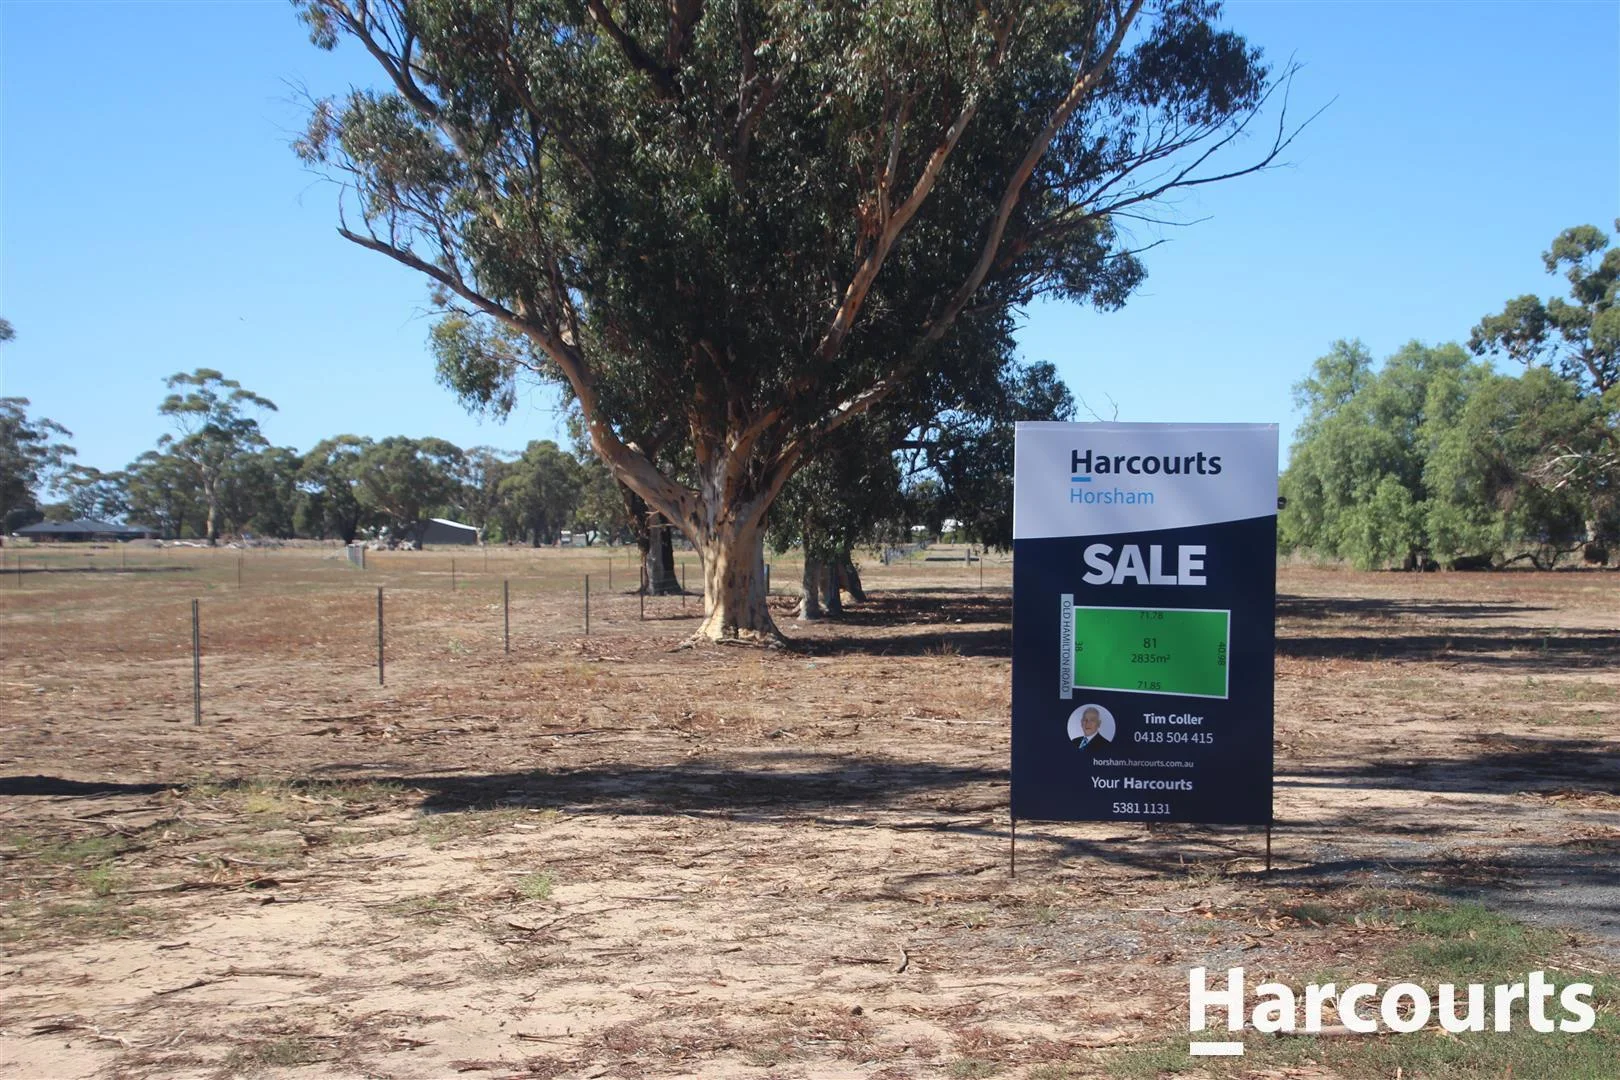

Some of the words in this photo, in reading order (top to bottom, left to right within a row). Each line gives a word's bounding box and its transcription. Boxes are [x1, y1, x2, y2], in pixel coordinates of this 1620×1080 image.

[1071, 449, 1222, 475] Harcourts
[1070, 488, 1154, 504] Horsham
[1082, 543, 1207, 586] SALE
[1062, 600, 1071, 619] OLD
[1062, 621, 1071, 666] HAMILTON
[1143, 638, 1157, 649] 81
[1061, 667, 1070, 693] ROAD
[1144, 713, 1165, 724] Tim
[1169, 714, 1204, 725] Coller
[1134, 731, 1163, 743] 0418
[1166, 732, 1188, 743] 504
[1191, 733, 1213, 744] 415
[1093, 758, 1194, 768] horsham.harcourts.com.au
[1091, 776, 1120, 788] Your
[1123, 777, 1193, 790] Harcourts
[1112, 802, 1140, 814] 5381
[1143, 803, 1171, 815] 1131
